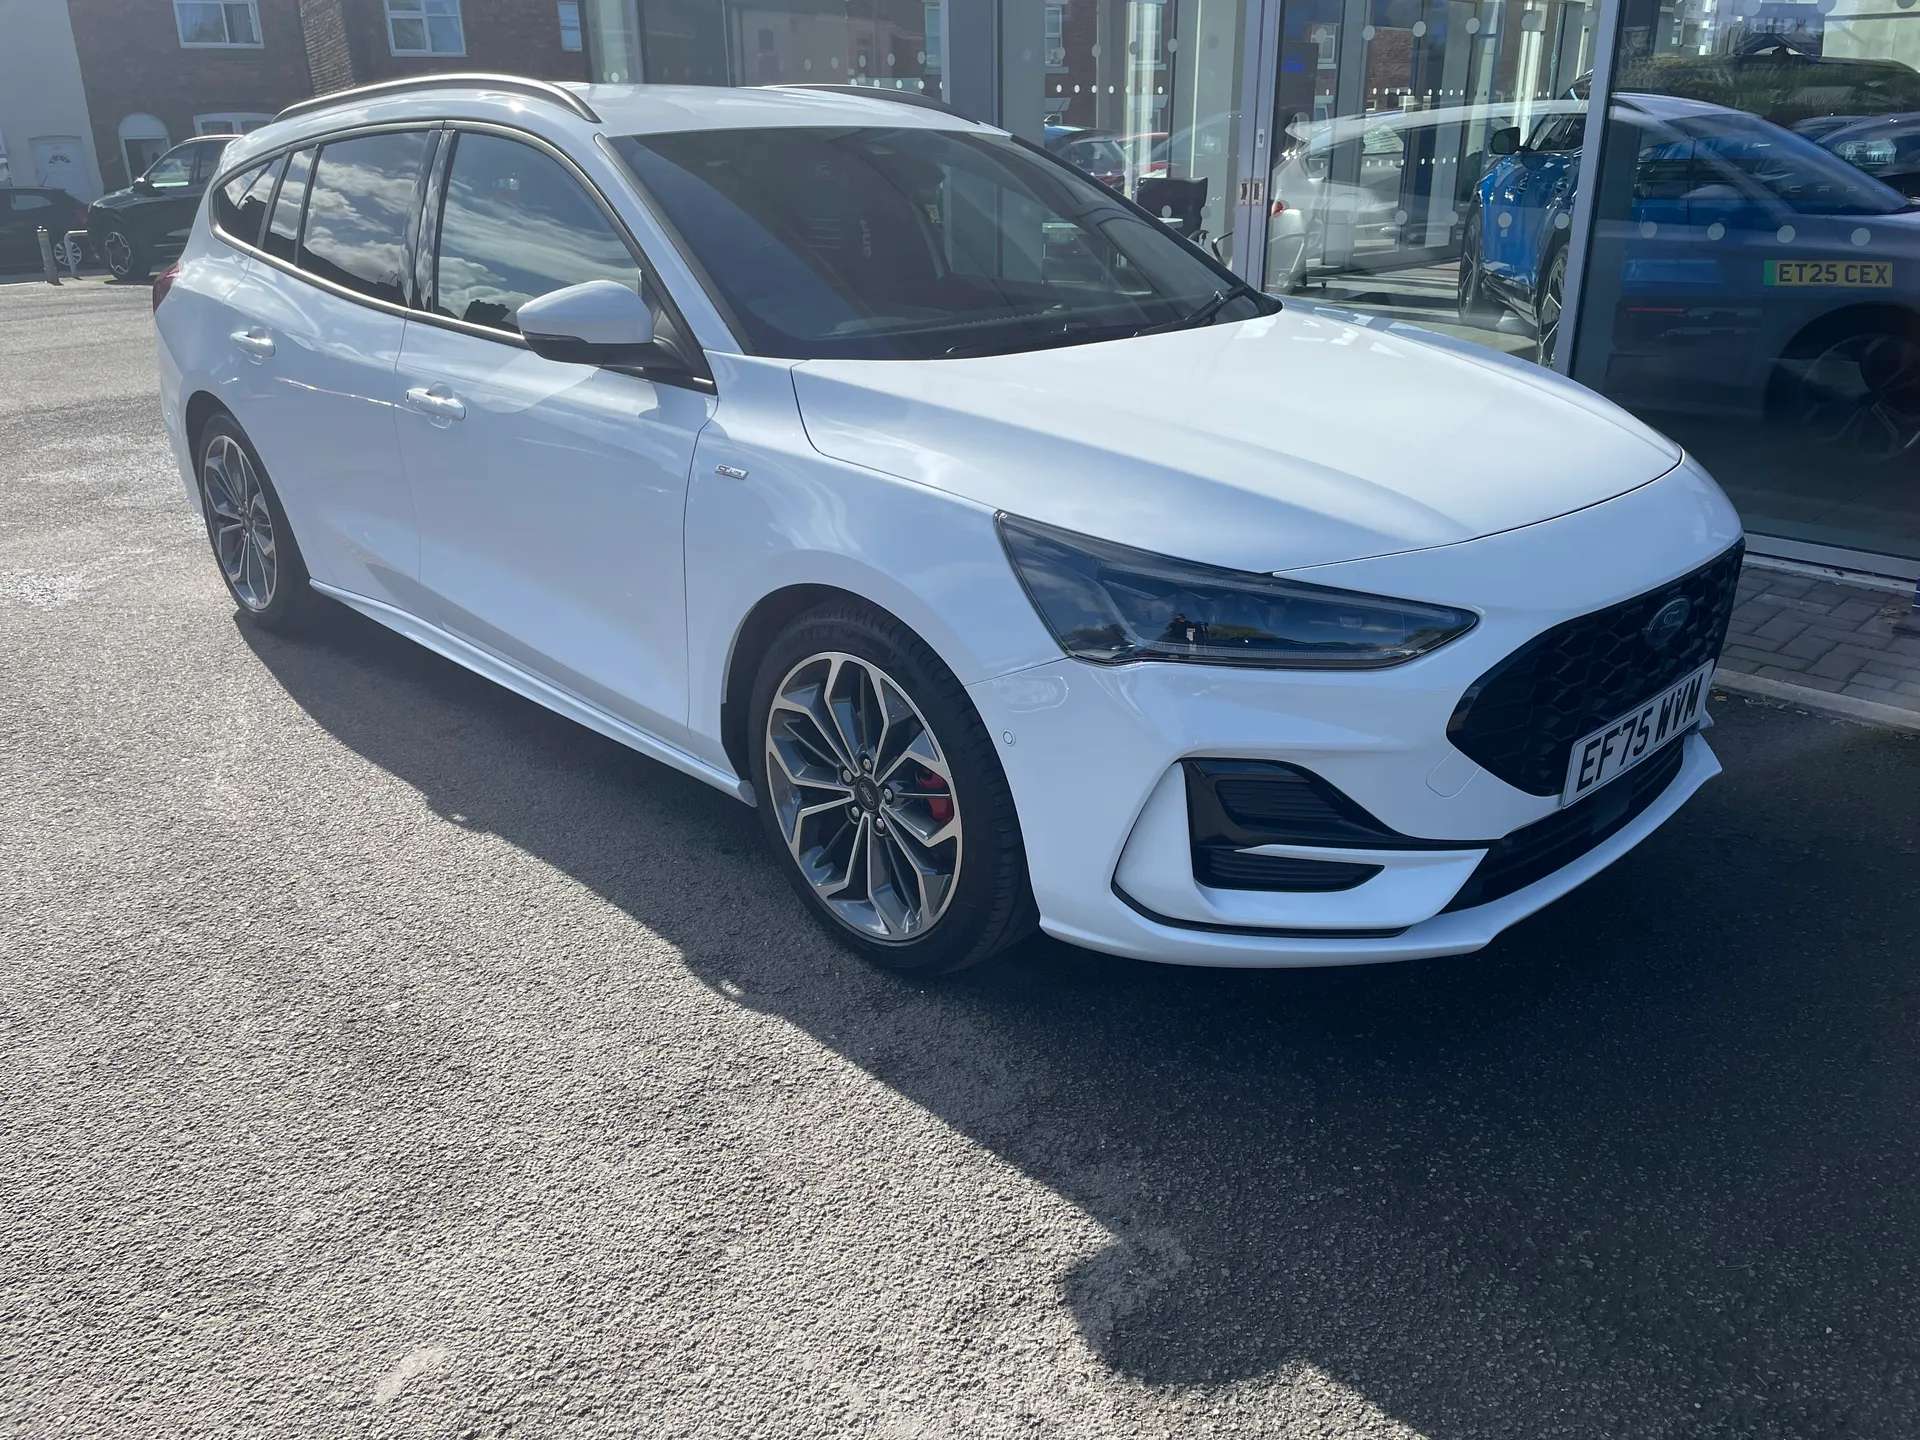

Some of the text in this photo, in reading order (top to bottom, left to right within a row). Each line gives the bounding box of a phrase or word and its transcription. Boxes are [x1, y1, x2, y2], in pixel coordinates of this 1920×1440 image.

[1779, 263, 1889, 285] ET25 CEX
[1576, 673, 1704, 793] EF75 WVM
